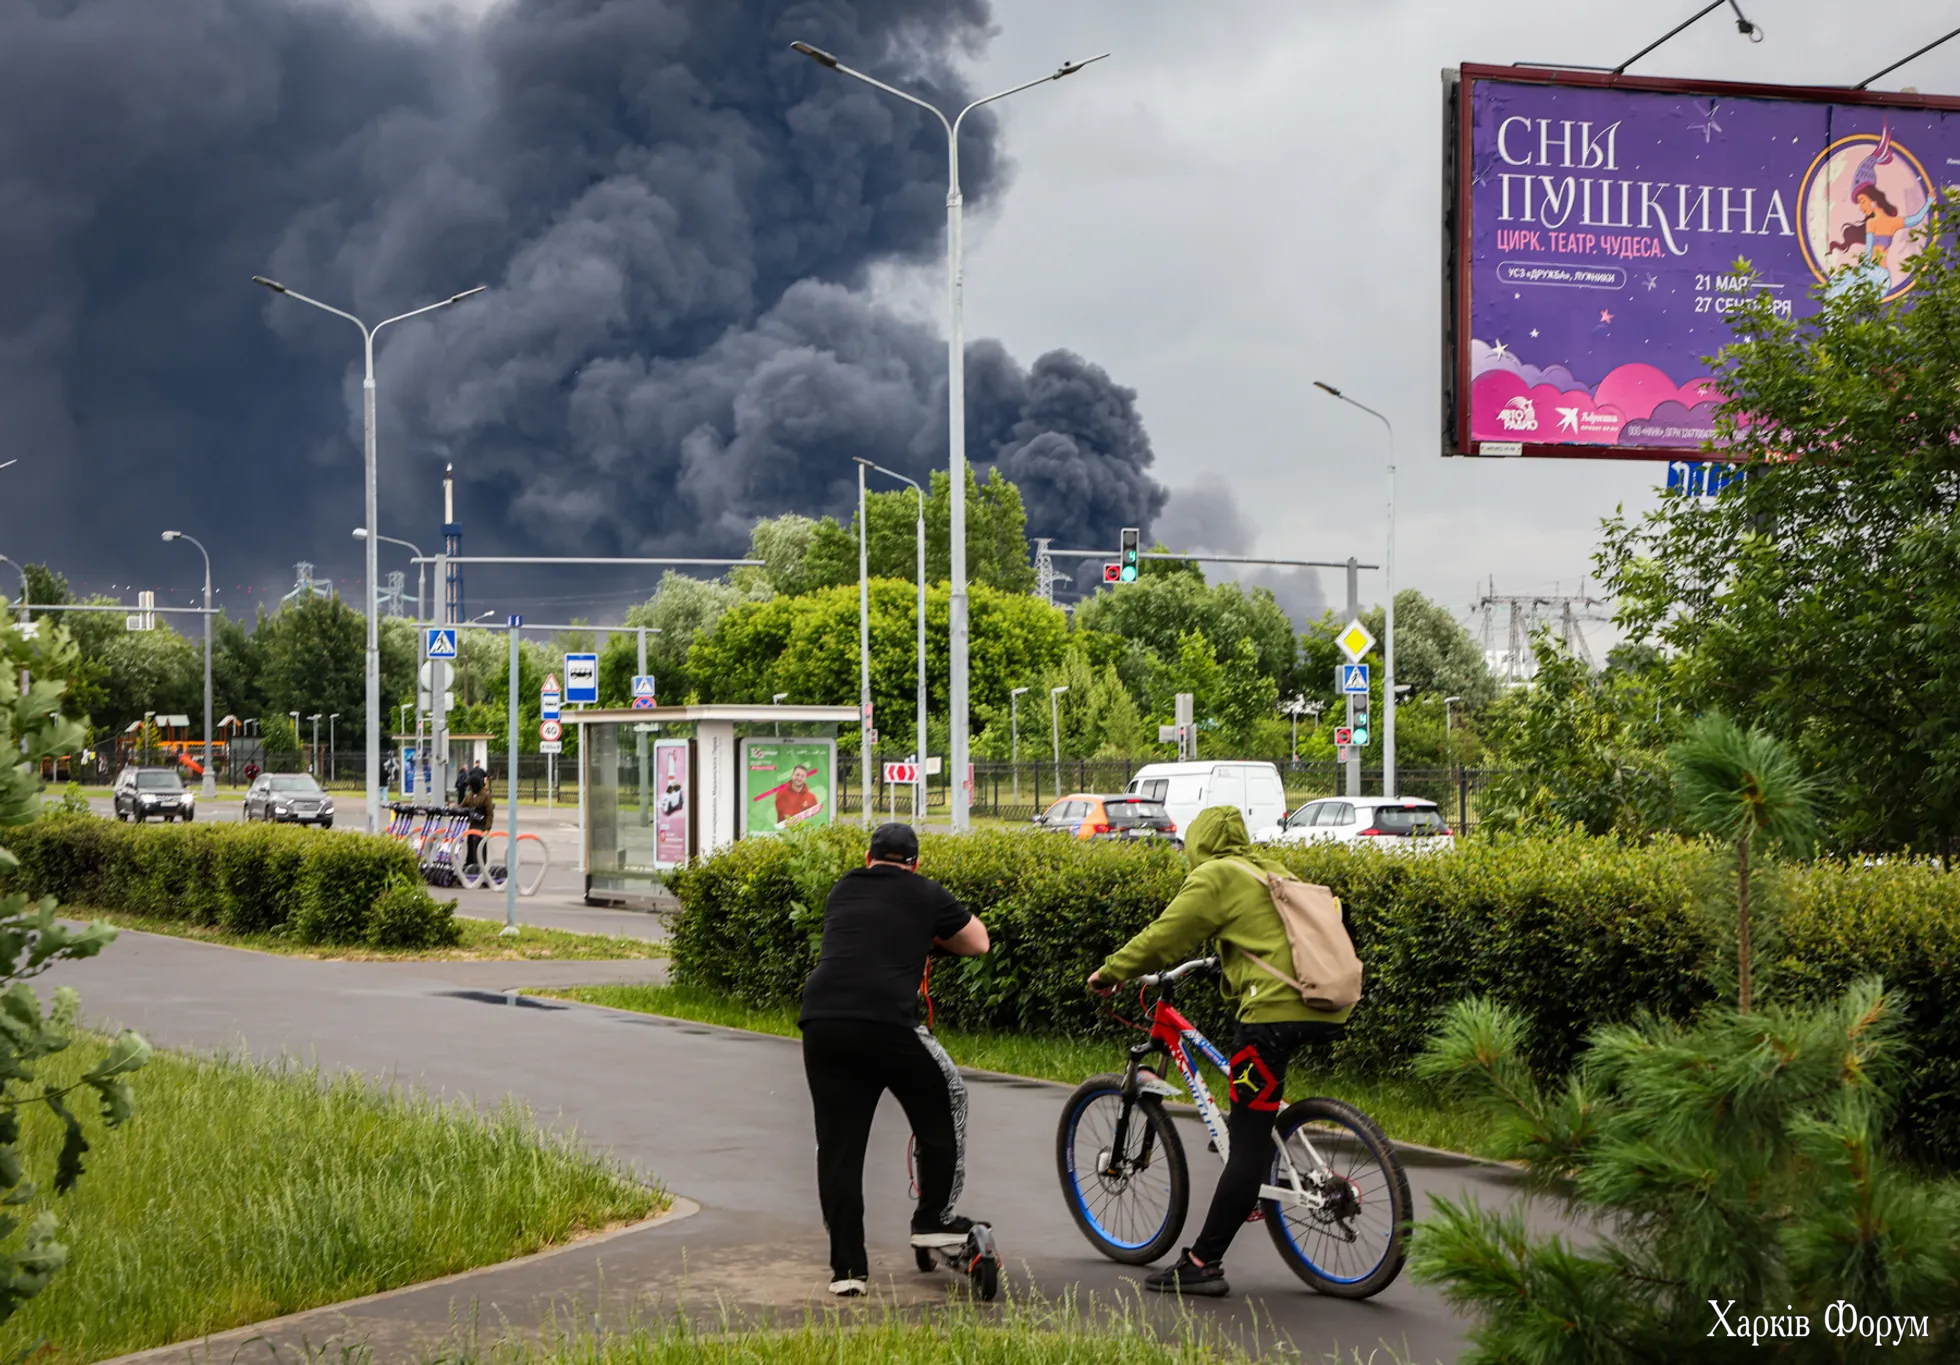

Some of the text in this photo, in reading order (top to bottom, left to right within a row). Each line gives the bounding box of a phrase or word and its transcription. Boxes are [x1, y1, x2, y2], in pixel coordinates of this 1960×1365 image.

[1498, 116, 1622, 170] СНЫ
[1497, 173, 1795, 256] ПУШКИНА
[1497, 229, 1667, 260] ЦИРК. ТЕАТР. ЧУДЕСА.
[1573, 271, 1616, 283] ЛУЖНИКИ
[1695, 274, 1711, 291] 21
[1715, 275, 1749, 292] МАЯ
[1694, 296, 1792, 315] 27 СЕНТРЯ
[1128, 550, 1136, 562] 4
